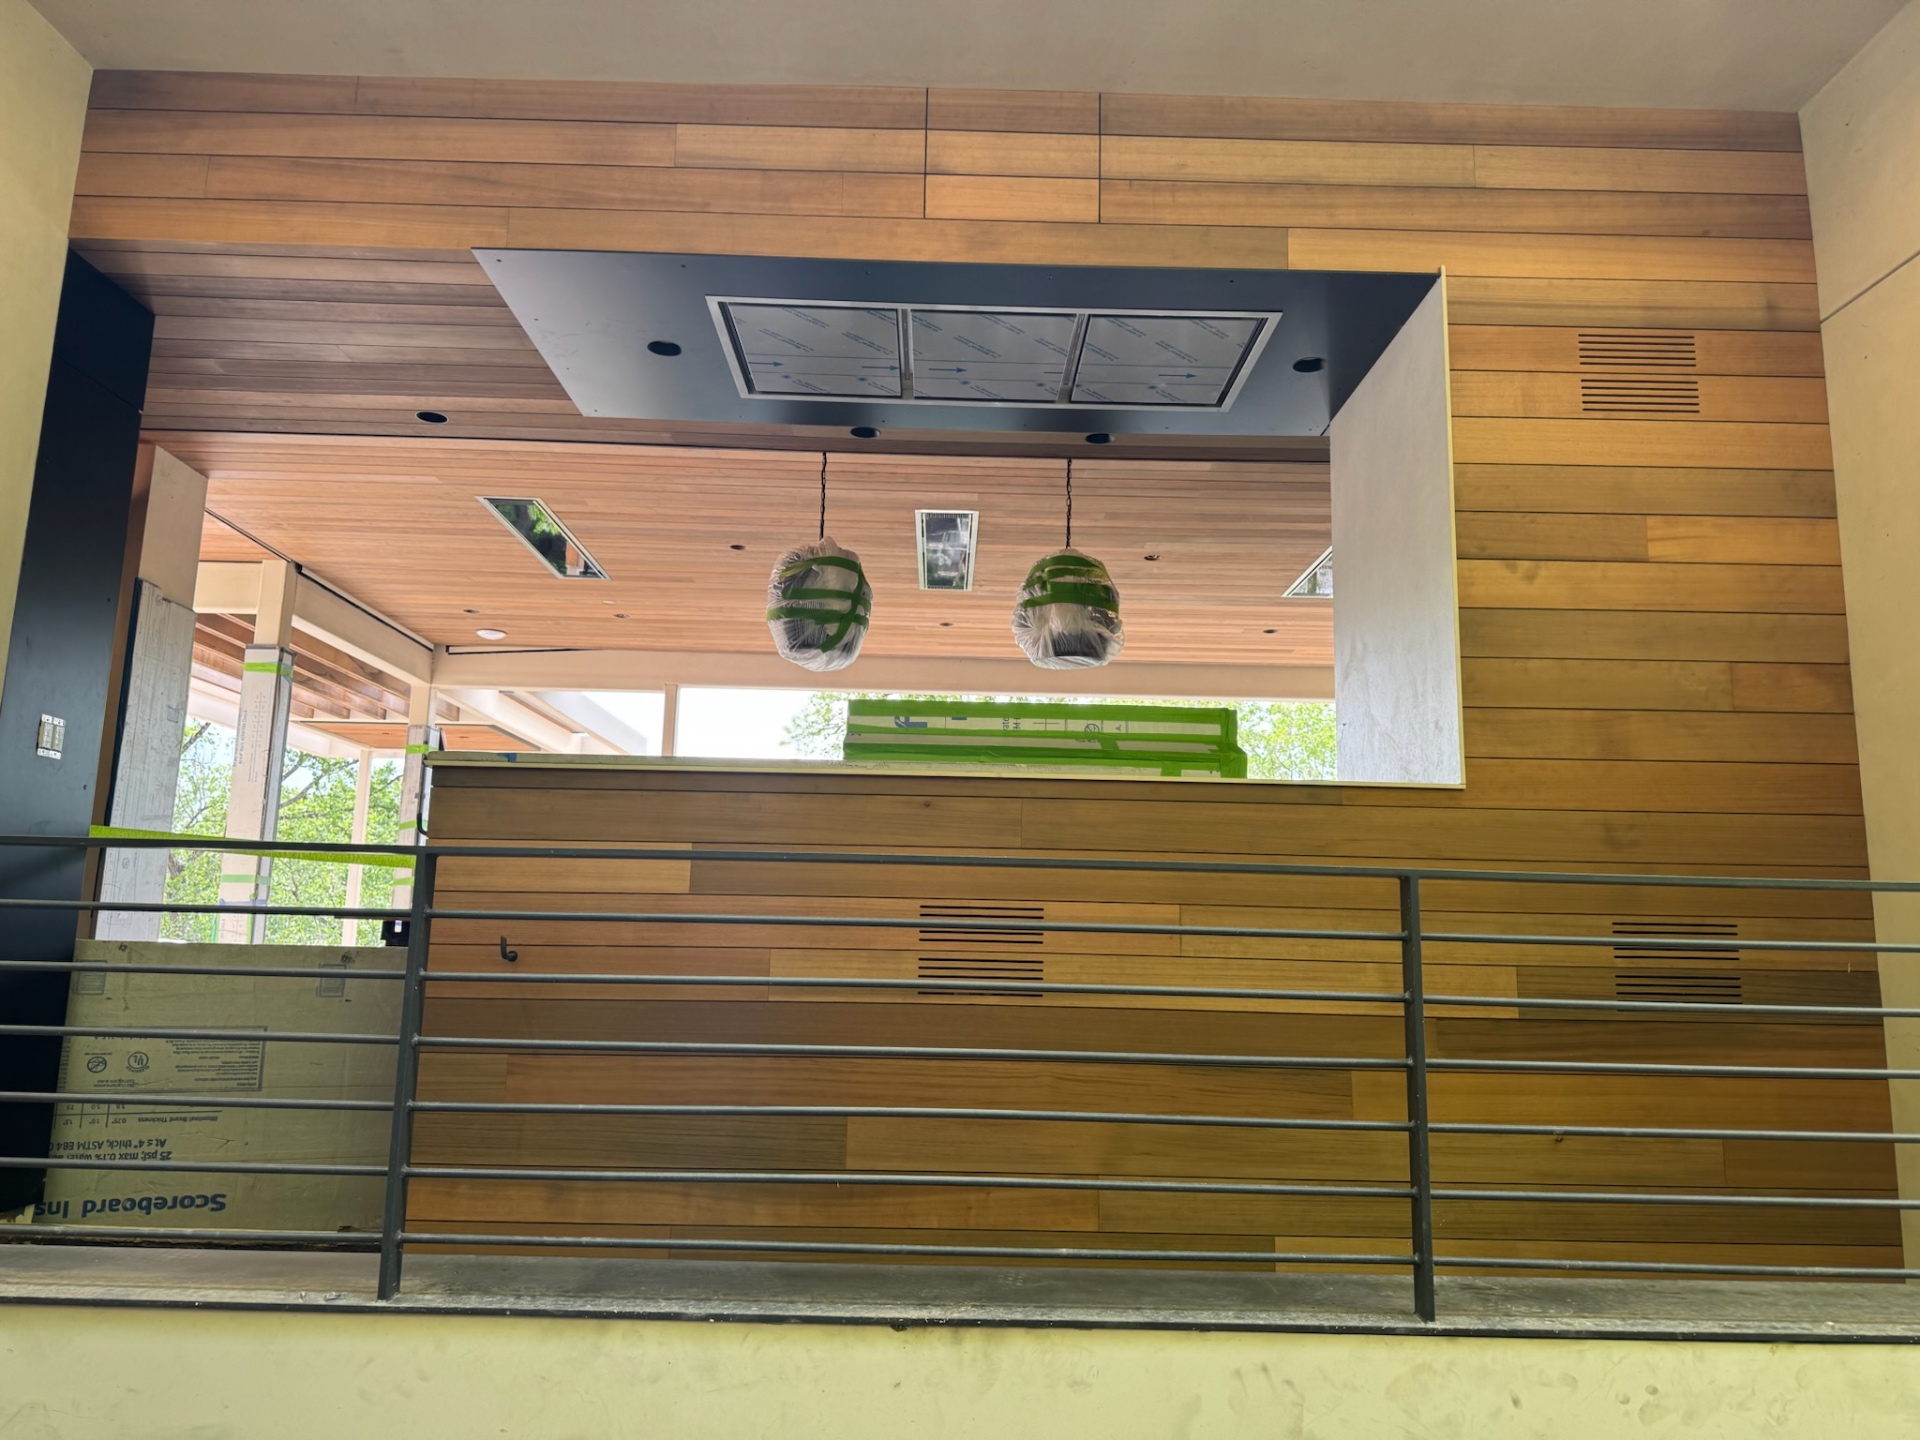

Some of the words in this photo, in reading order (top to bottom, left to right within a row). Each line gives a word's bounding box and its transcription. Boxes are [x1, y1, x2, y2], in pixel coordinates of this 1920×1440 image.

[57, 1142, 75, 1151] E84
[77, 1141, 104, 1150] ASTM
[106, 1139, 132, 1150] thick,
[155, 1139, 167, 1148] At
[119, 1152, 139, 1160] max
[141, 1150, 158, 1161] psi;
[160, 1151, 173, 1161] 25
[81, 1194, 227, 1218] Scoreboard
